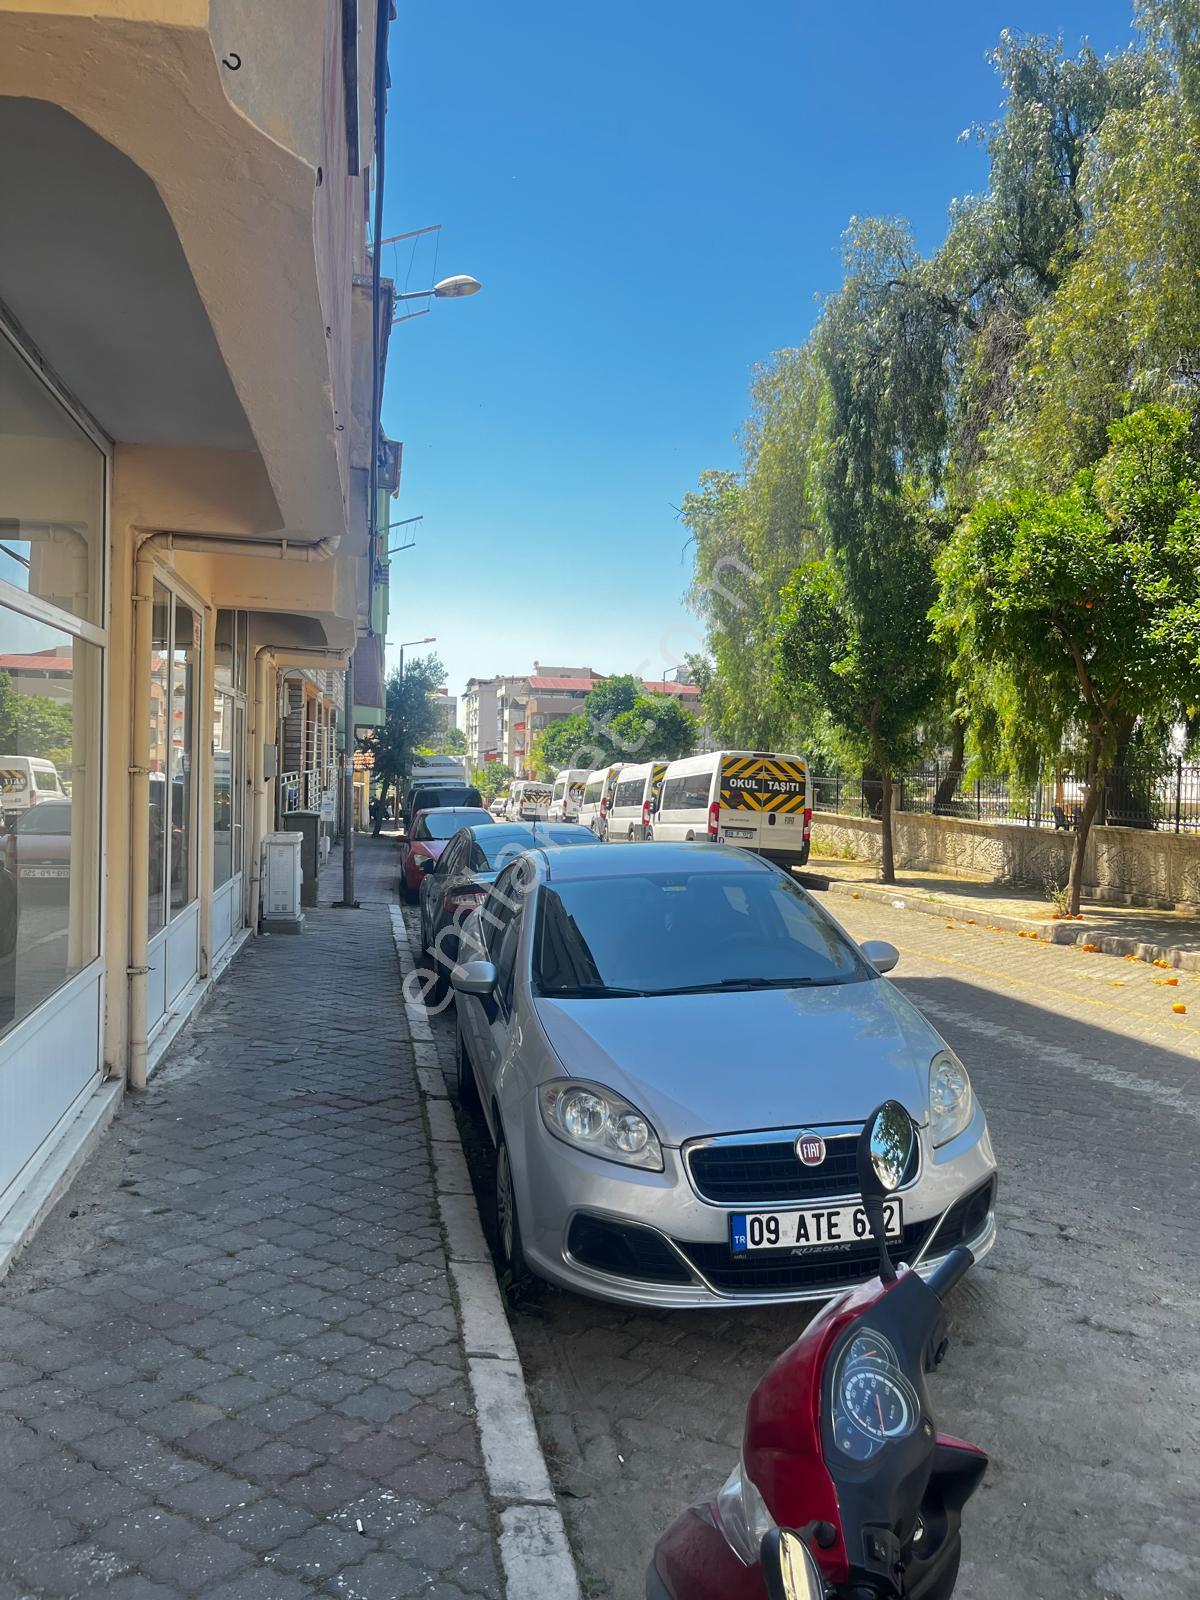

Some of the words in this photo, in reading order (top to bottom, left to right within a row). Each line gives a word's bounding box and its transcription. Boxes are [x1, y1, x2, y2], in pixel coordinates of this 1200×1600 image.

[729, 778, 758, 789] OKUL
[767, 781, 799, 792] TAŞITI
[802, 1142, 820, 1159] FIAT
[749, 1216, 780, 1246] 09
[795, 1211, 841, 1244] ATE
[852, 1205, 895, 1237] 62
[734, 1235, 746, 1245] TR
